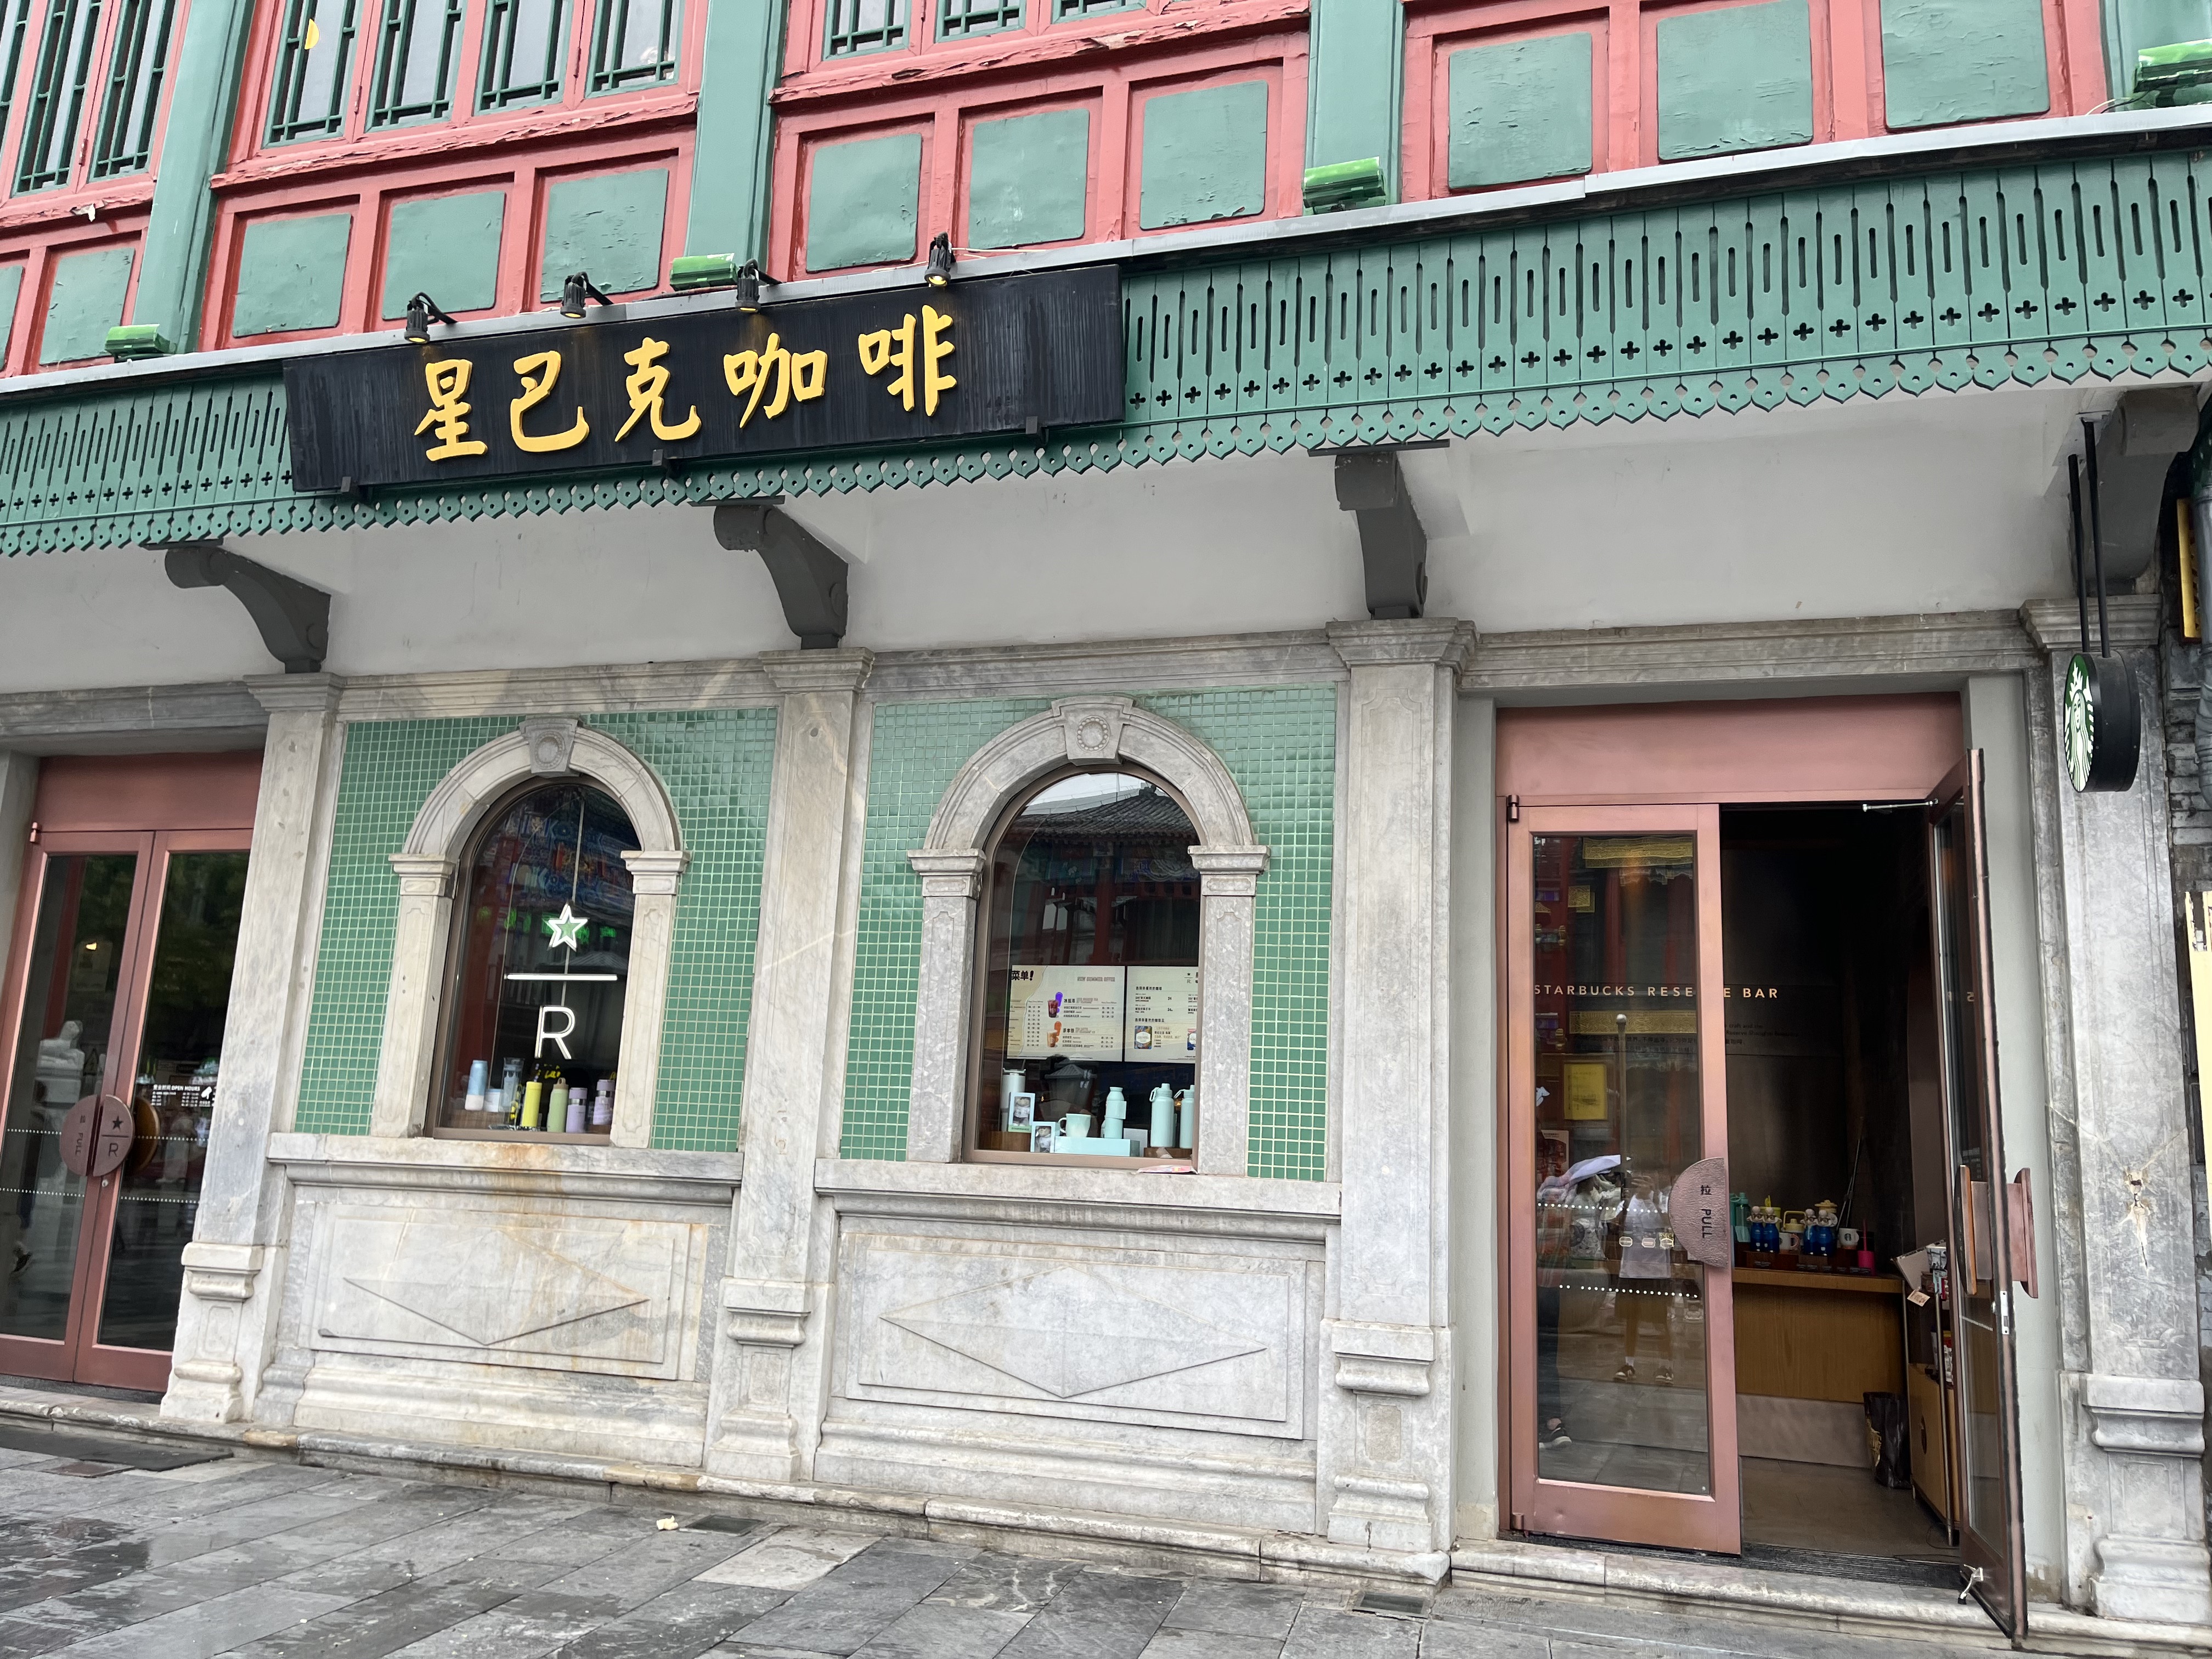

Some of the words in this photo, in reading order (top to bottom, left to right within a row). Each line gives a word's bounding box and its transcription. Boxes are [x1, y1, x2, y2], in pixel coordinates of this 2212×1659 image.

[414, 304, 958, 461] 星巴克咖啡
[1534, 984, 1635, 996] STARBUCKS
[1647, 986, 1731, 997] RESEE
[1743, 988, 1778, 998] BAR
[534, 1005, 575, 1059] R
[75, 1132, 83, 1157] PULL
[108, 1142, 119, 1158] R
[1700, 1184, 1712, 1195] 拉
[1701, 1209, 1713, 1239] PULL
